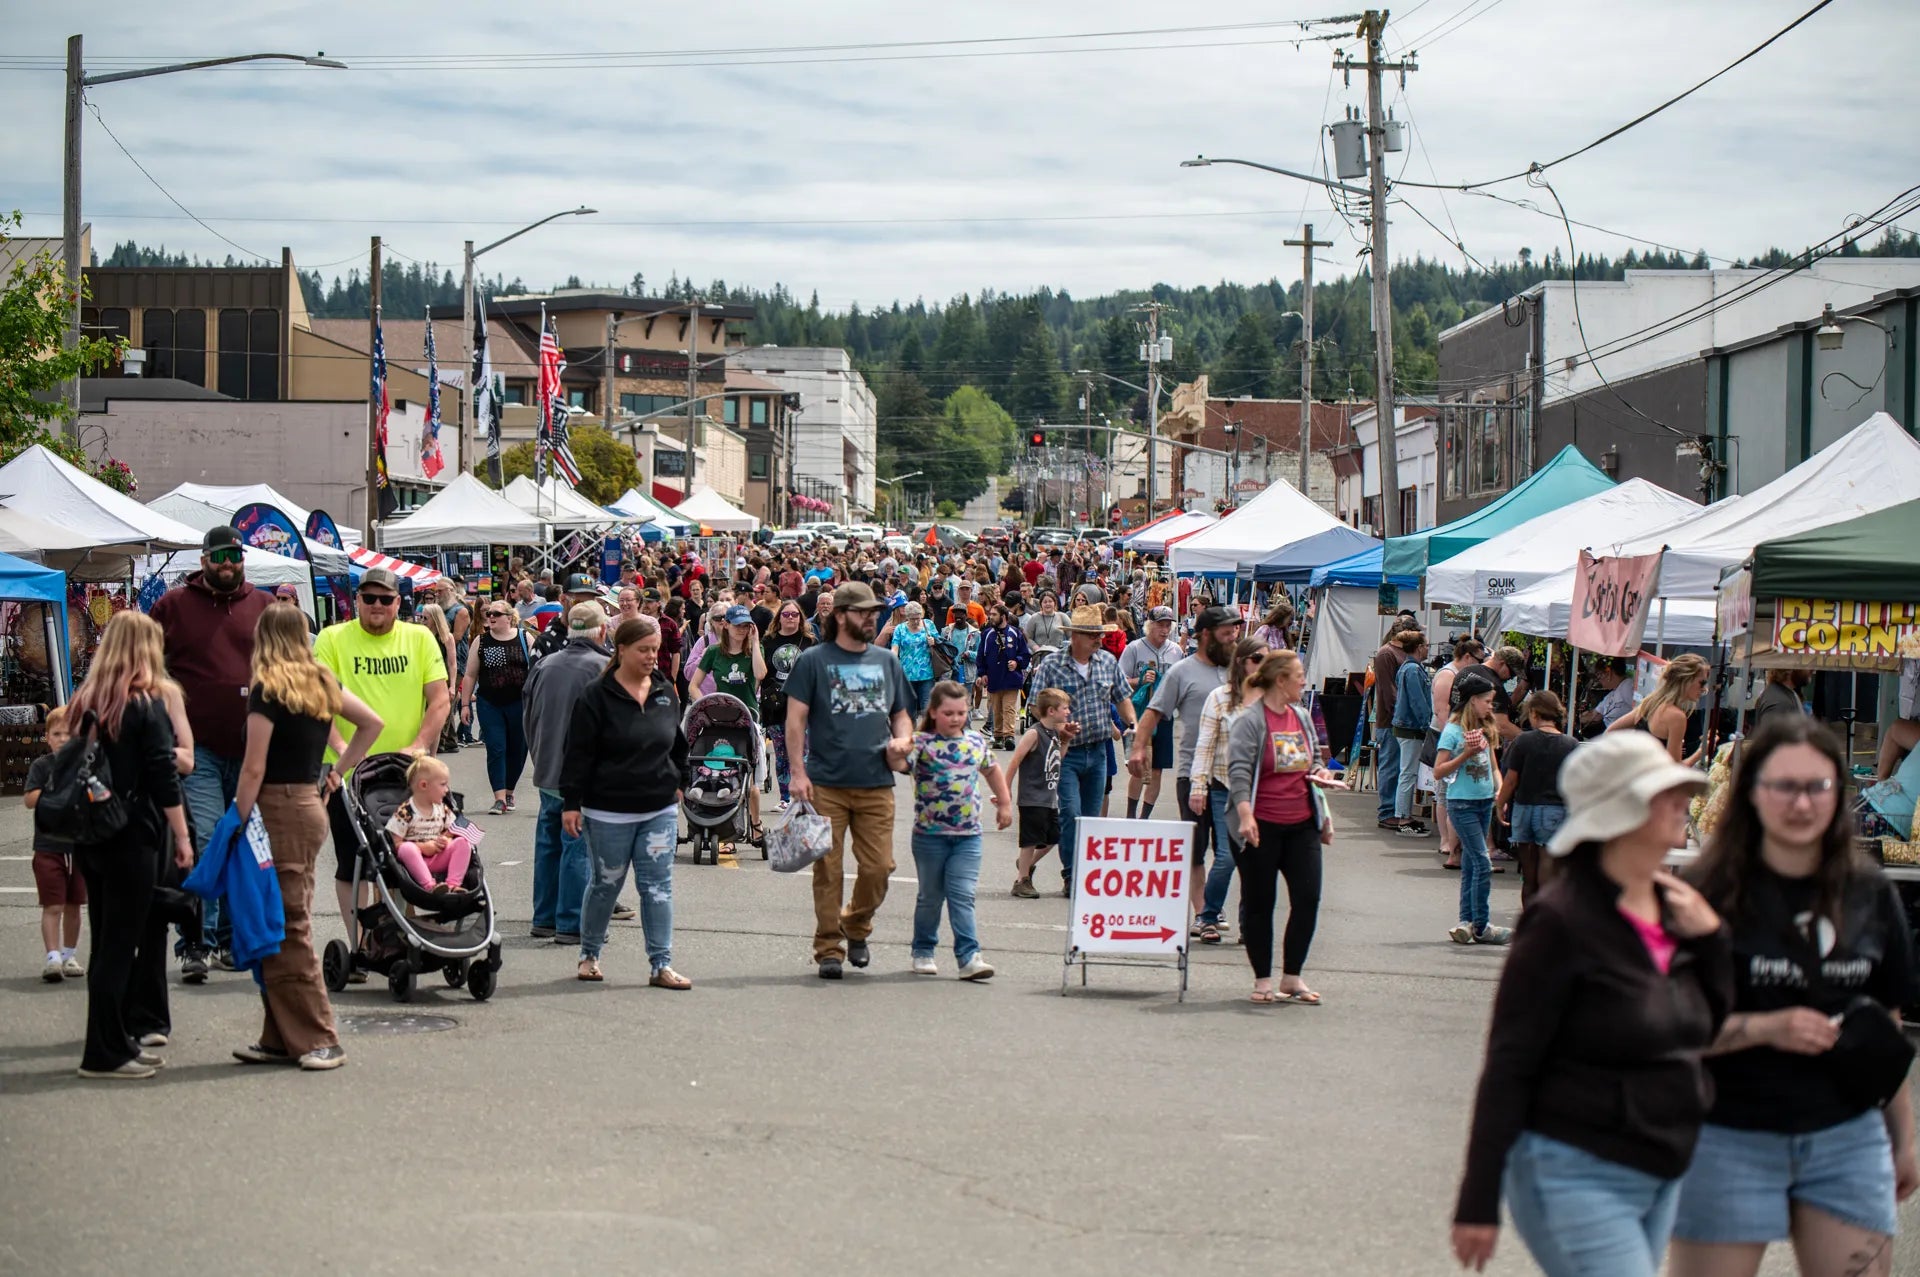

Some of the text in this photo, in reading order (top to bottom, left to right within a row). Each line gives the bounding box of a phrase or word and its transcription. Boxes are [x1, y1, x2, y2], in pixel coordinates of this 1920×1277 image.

[1487, 587, 1516, 596] SHADE
[1488, 577, 1516, 588] QUIK
[1779, 620, 1898, 654] CORN
[353, 655, 408, 675] F-TROOP
[1086, 836, 1184, 863] KETTLE
[1085, 868, 1182, 898] CORN!
[1082, 913, 1156, 938] $8.00 EACH
